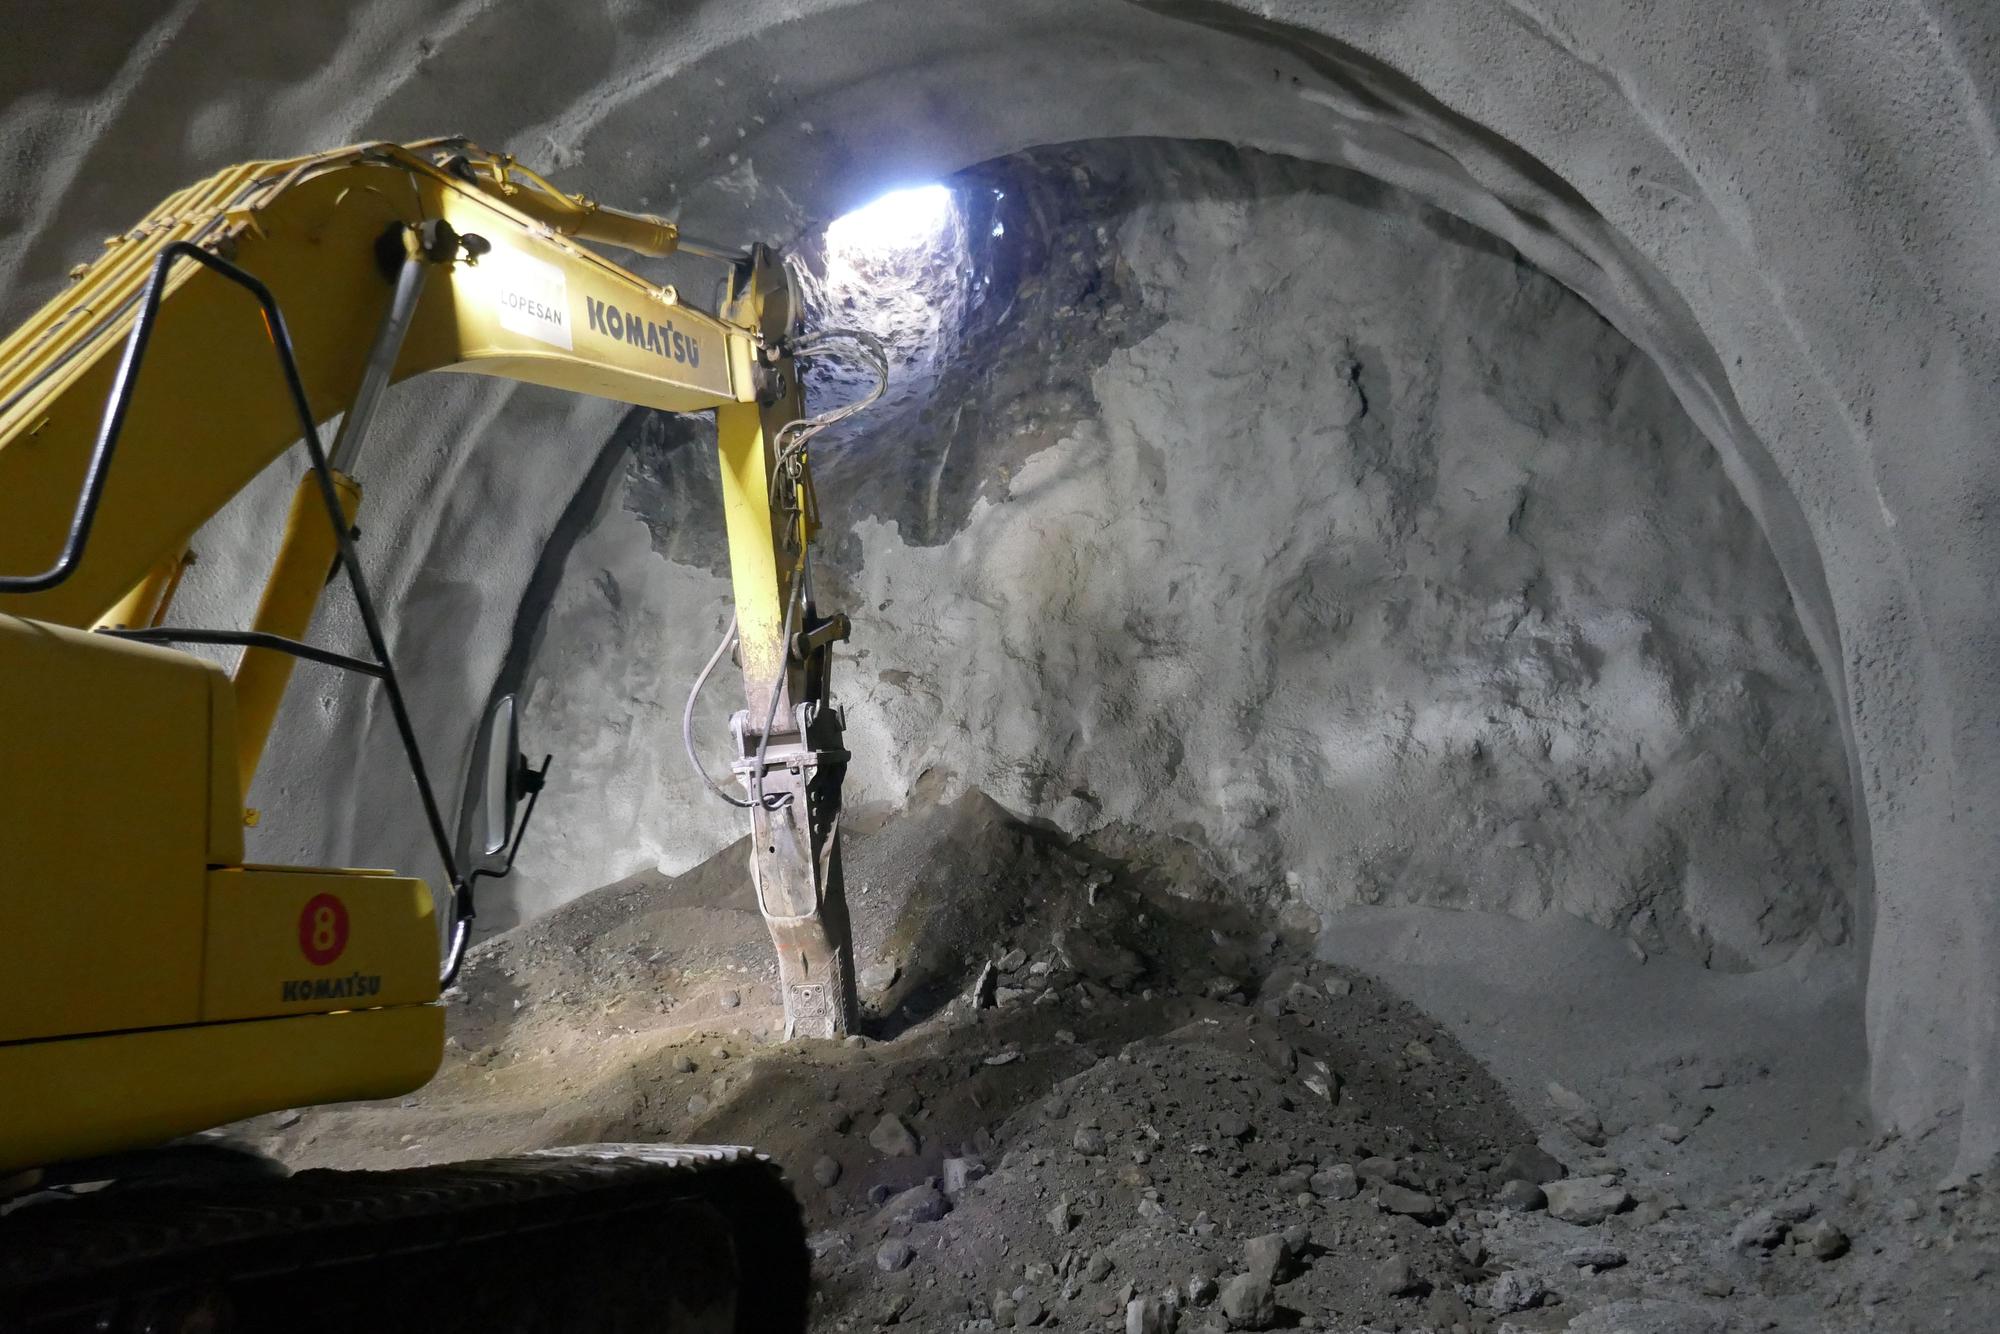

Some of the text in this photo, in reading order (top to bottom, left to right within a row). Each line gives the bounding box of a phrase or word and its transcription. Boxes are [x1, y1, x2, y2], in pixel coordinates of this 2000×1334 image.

[501, 288, 562, 326] LOPESAN
[586, 297, 700, 368] KOMATSU
[313, 907, 336, 951] 8
[282, 972, 380, 1002] KOMATSU
